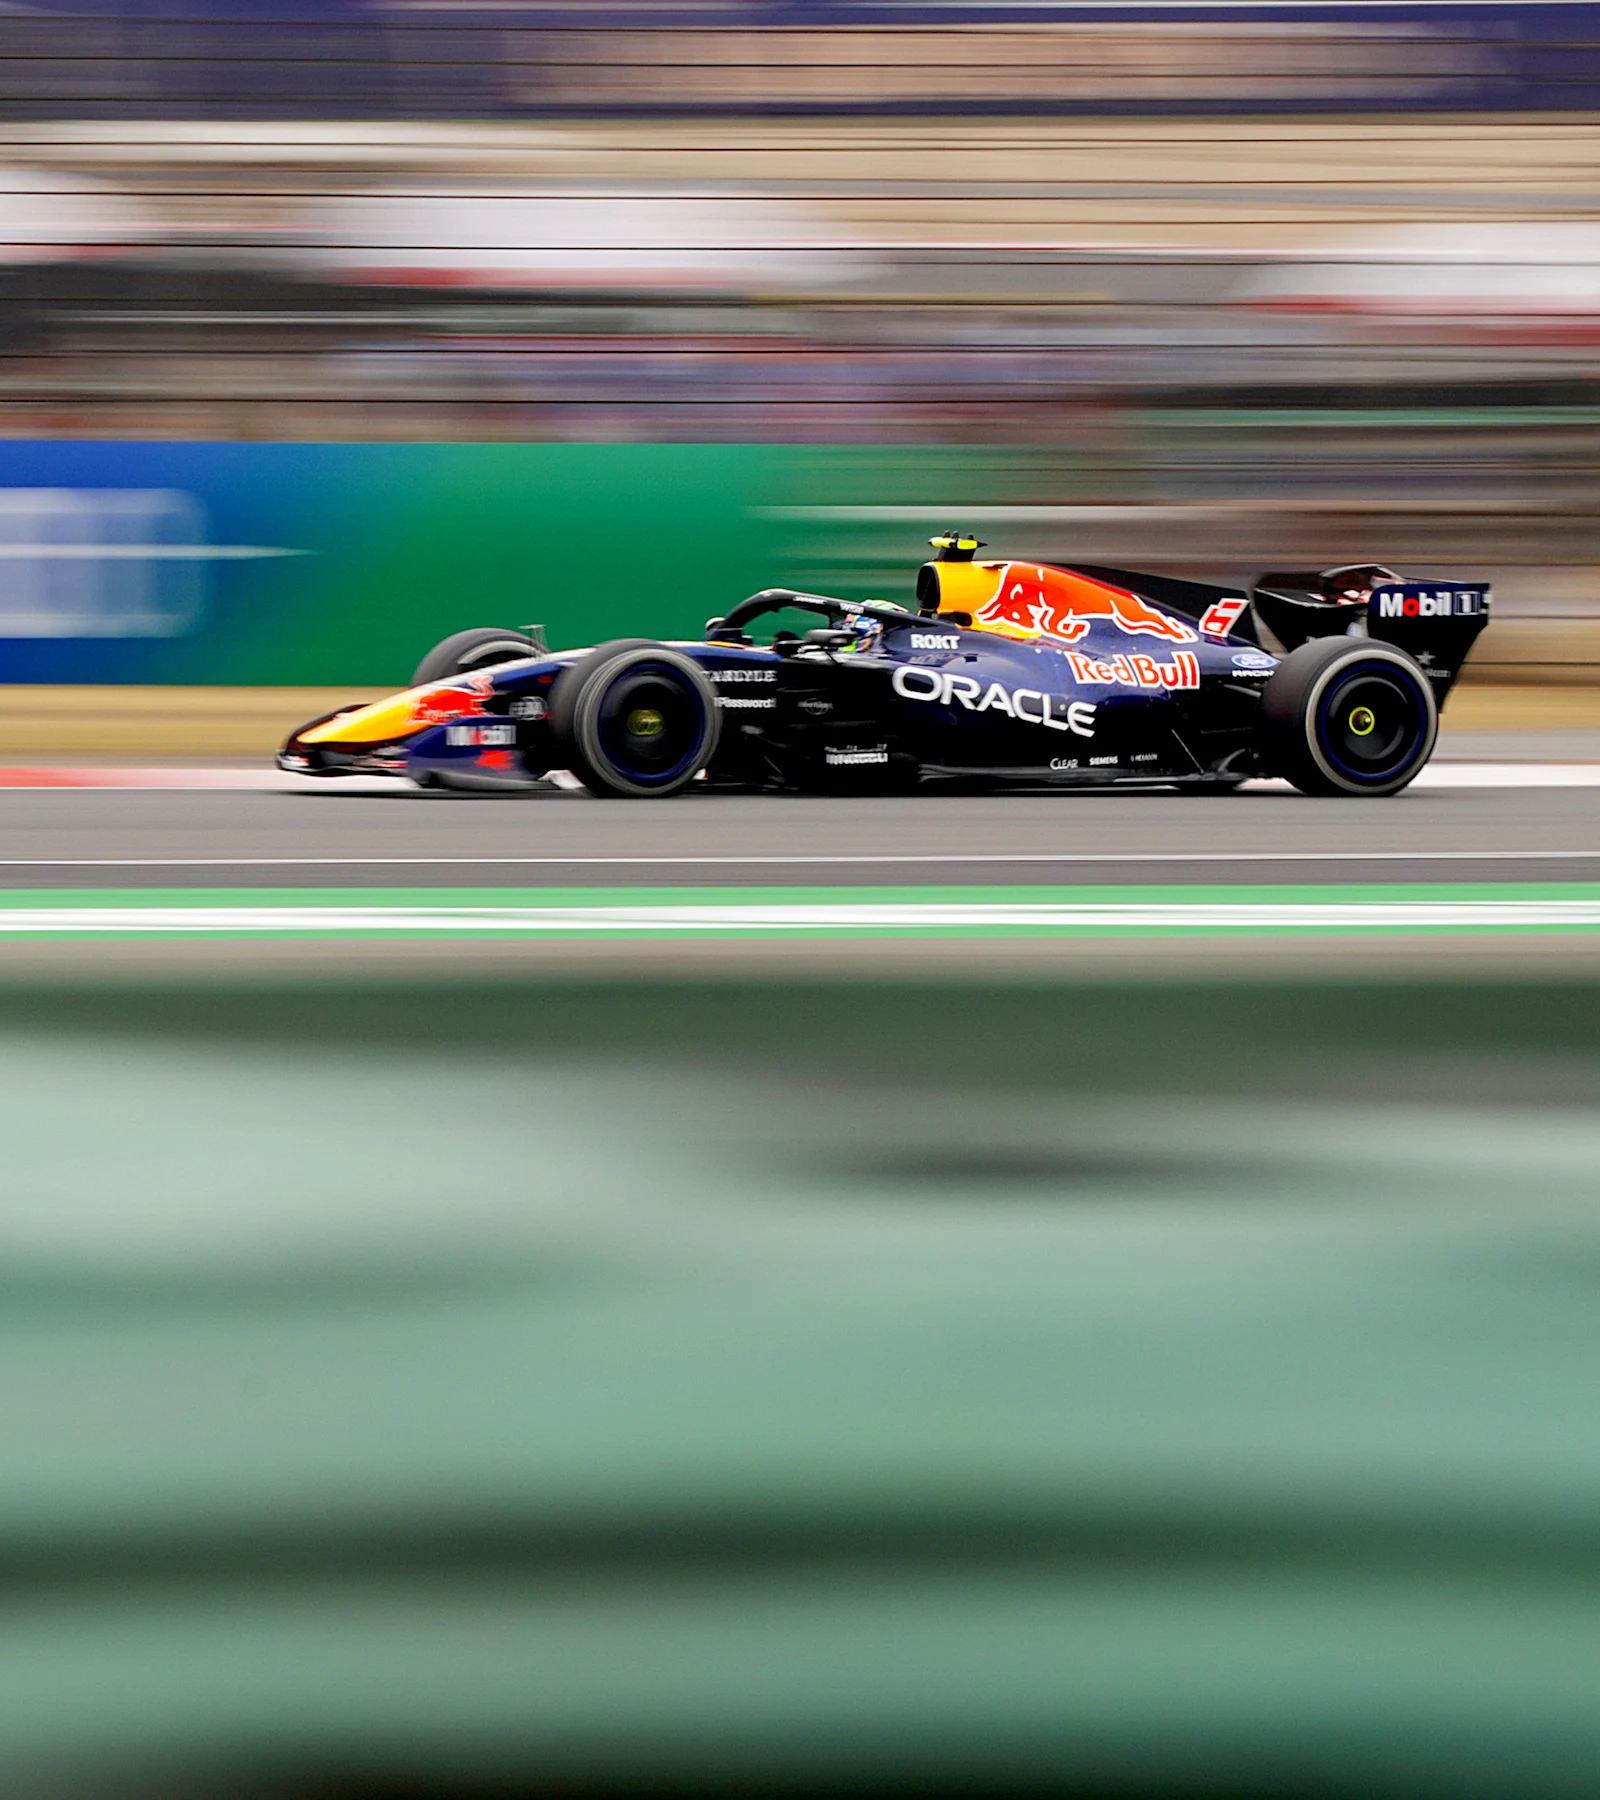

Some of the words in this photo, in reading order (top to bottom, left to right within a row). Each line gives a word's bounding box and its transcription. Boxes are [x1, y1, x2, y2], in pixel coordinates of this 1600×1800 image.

[1202, 600, 1245, 635] 6
[1380, 592, 1452, 617] Mobil
[1458, 593, 1475, 615] 1
[911, 634, 960, 650] ROKT
[1068, 653, 1135, 684] Red
[1132, 654, 1197, 687] Bull
[892, 666, 1097, 738] ORACLE
[1089, 756, 1119, 766] SIEMENS
